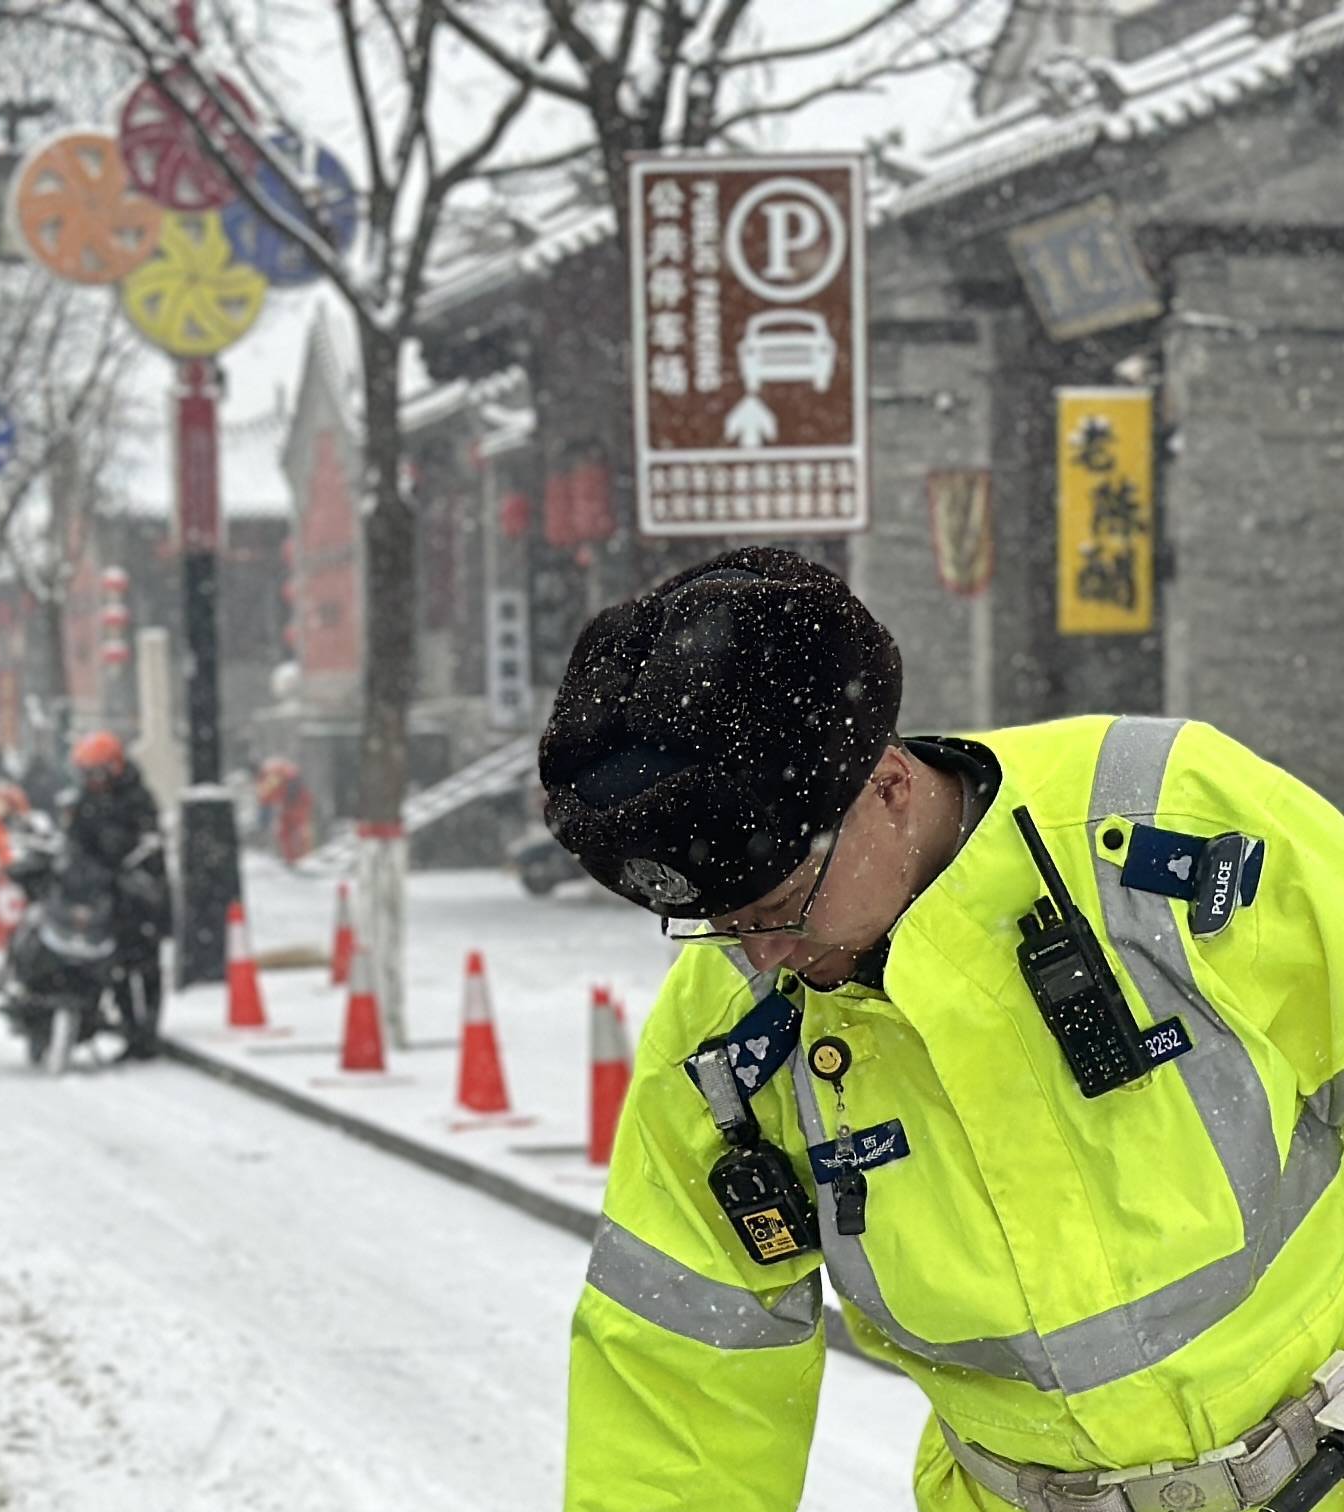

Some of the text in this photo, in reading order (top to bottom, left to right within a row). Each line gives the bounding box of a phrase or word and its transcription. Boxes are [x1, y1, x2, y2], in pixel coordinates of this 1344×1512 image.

[760, 201, 821, 279] P
[1211, 860, 1233, 915] POLICE
[1145, 1028, 1182, 1058] 3252
